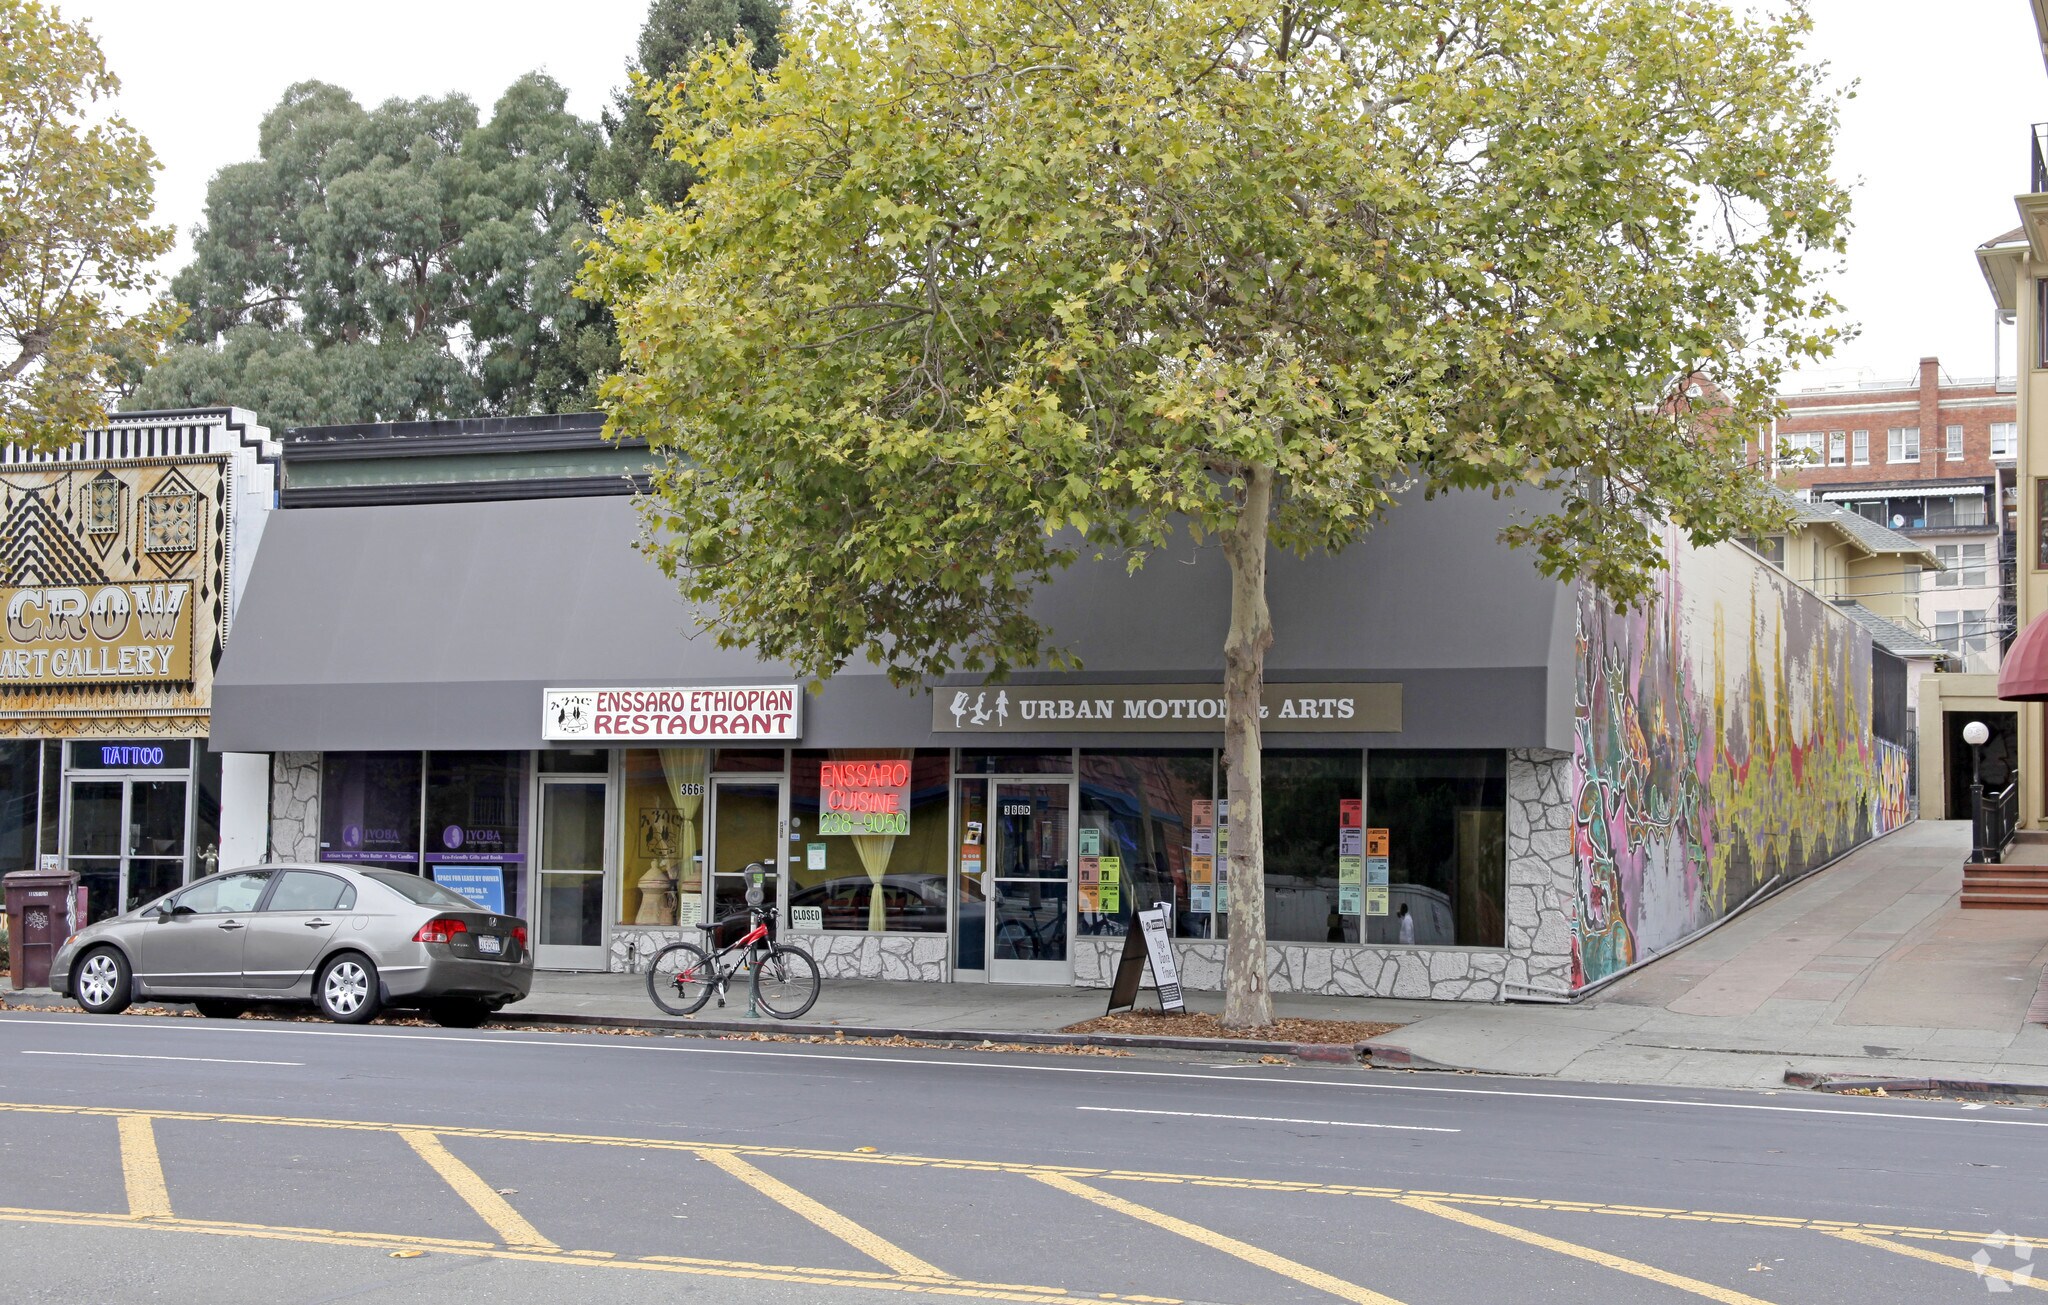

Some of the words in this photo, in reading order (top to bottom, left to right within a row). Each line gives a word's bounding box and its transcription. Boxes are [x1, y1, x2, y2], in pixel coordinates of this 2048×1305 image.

[7, 584, 188, 643] CROW
[0, 648, 49, 679] ART
[51, 645, 175, 678] GALLERY
[597, 691, 684, 712] ENSSARO
[691, 690, 792, 712] ETHIOPIAN
[1020, 699, 1114, 719] URBAN
[1278, 698, 1355, 719] ARTS
[594, 713, 792, 734] RESTAURANT
[101, 746, 164, 765] TATTOO
[820, 763, 908, 787] ENSSARO
[828, 790, 899, 813] CUISINE
[820, 812, 907, 833] 238-9050
[365, 829, 399, 839] IYOBA
[466, 830, 501, 840] IYOBA
[793, 909, 820, 921] CLOSED
